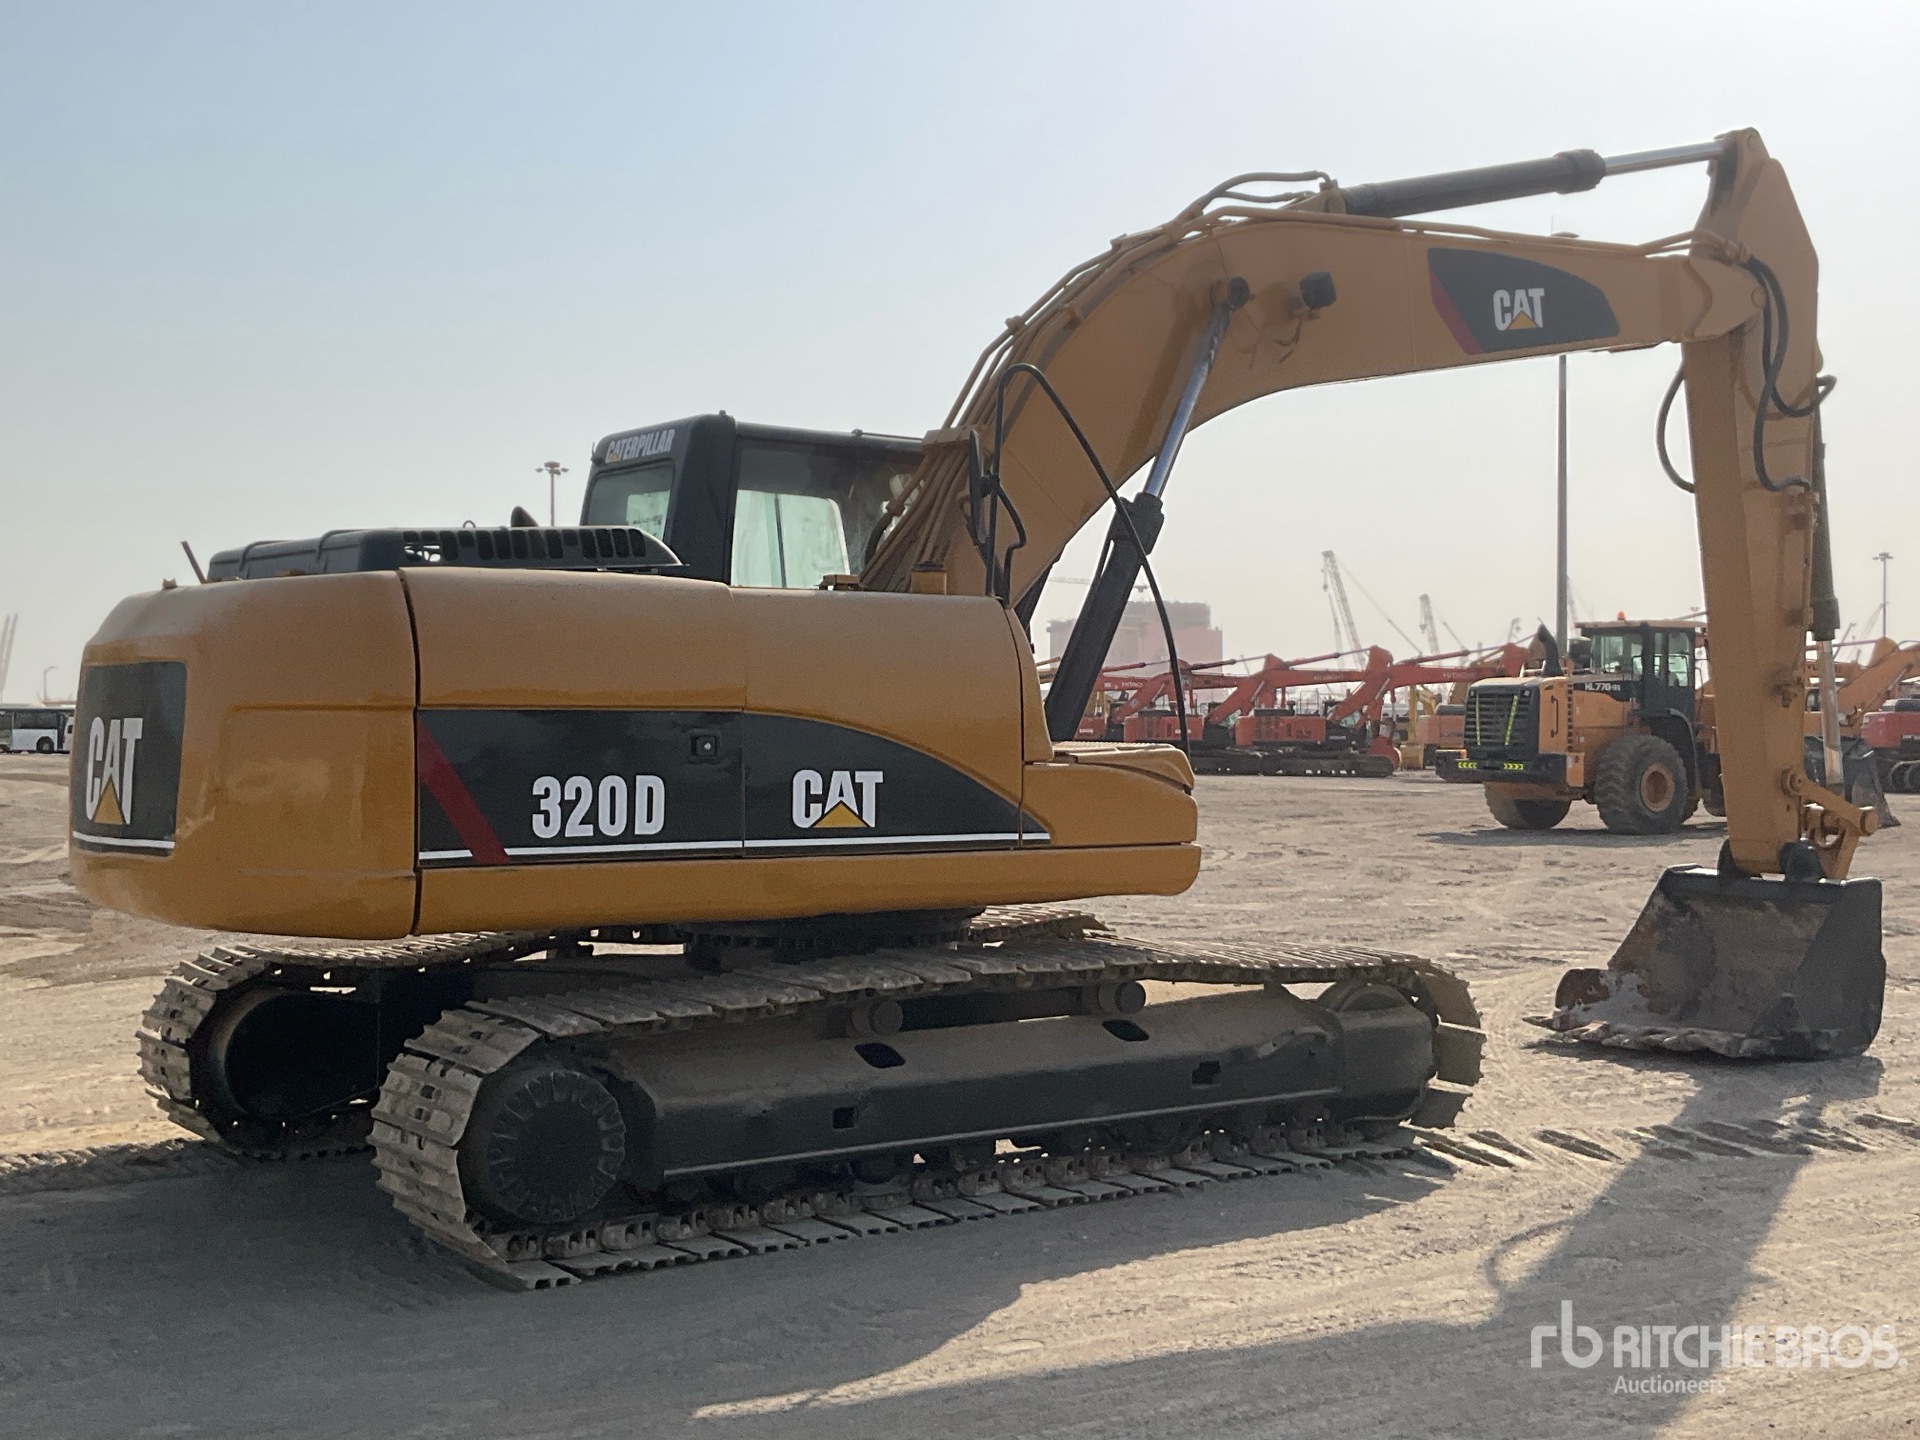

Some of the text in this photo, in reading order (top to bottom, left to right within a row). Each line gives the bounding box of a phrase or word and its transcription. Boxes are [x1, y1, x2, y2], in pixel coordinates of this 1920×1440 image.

[1493, 288, 1545, 331] CAT
[605, 429, 675, 464] CATERPILLAR
[86, 716, 143, 825] CAT
[792, 769, 883, 828] CAT
[532, 775, 665, 838] 320D
